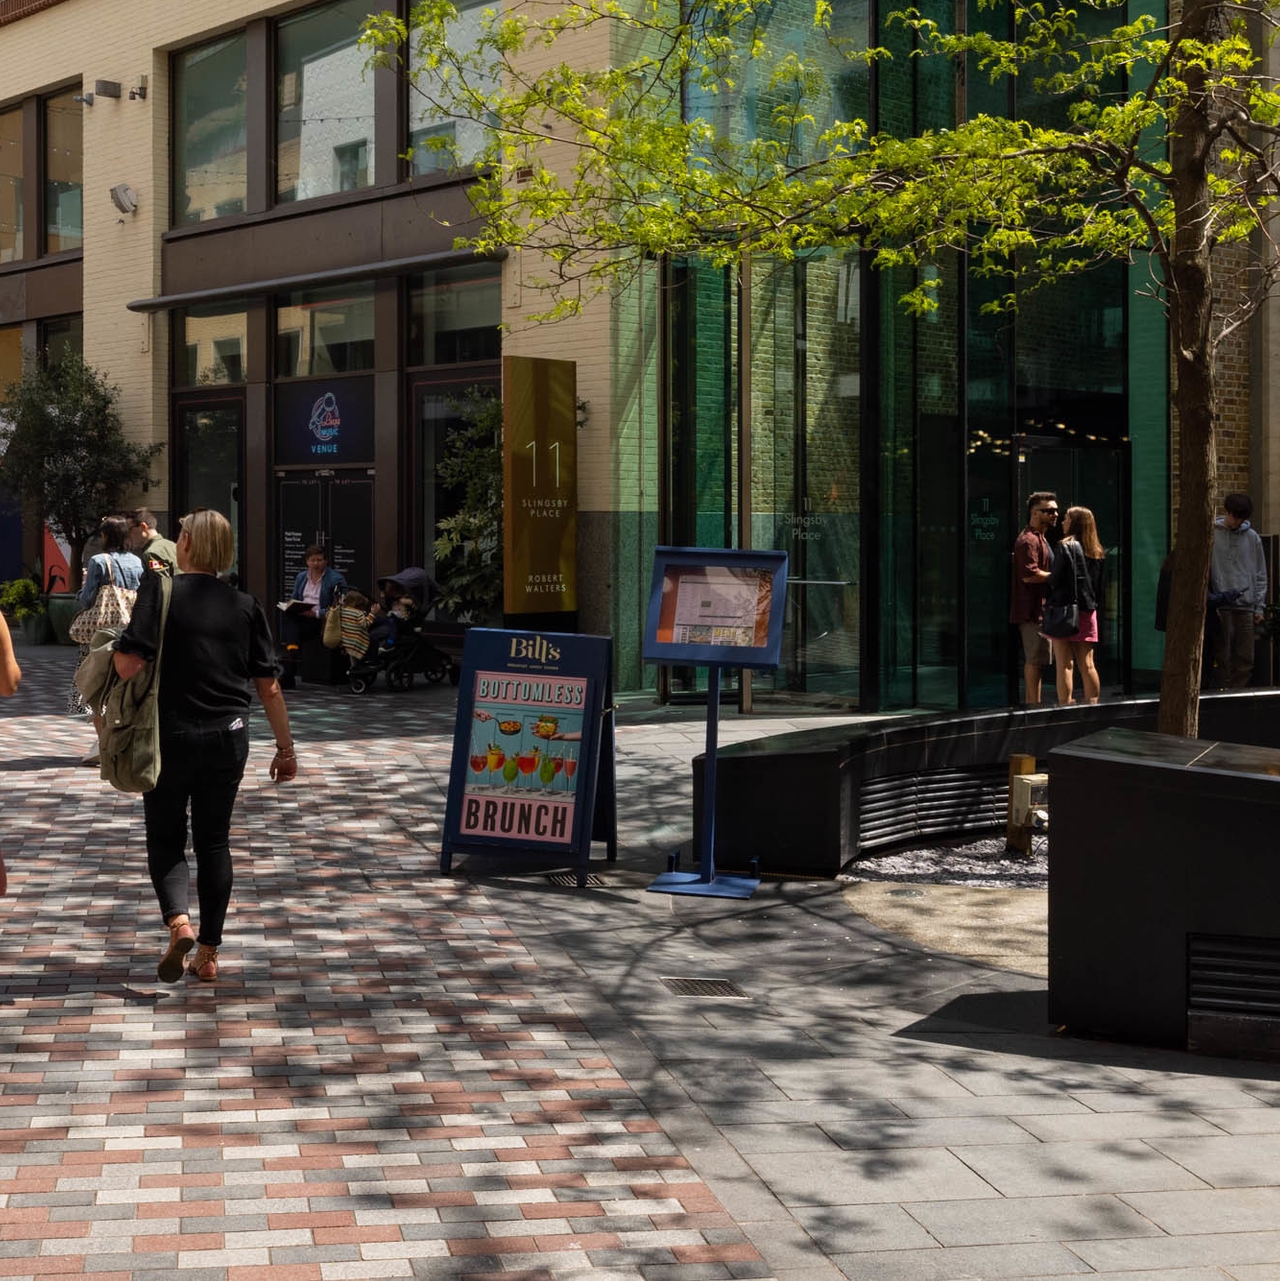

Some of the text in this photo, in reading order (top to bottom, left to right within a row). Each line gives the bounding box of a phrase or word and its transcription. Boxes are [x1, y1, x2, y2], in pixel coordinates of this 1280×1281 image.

[311, 444, 338, 454] VENUE
[525, 439, 561, 488] 11
[522, 499, 569, 508] SLINGSBY
[530, 509, 561, 518] PLACE
[784, 512, 828, 527] Slingsby
[792, 527, 822, 540] Place
[528, 574, 564, 583] ROBERT
[525, 584, 567, 593] WALTERS
[509, 635, 561, 664] Bill's
[478, 677, 584, 705] BOTTOMLESS
[465, 798, 568, 838] BRUNCH
